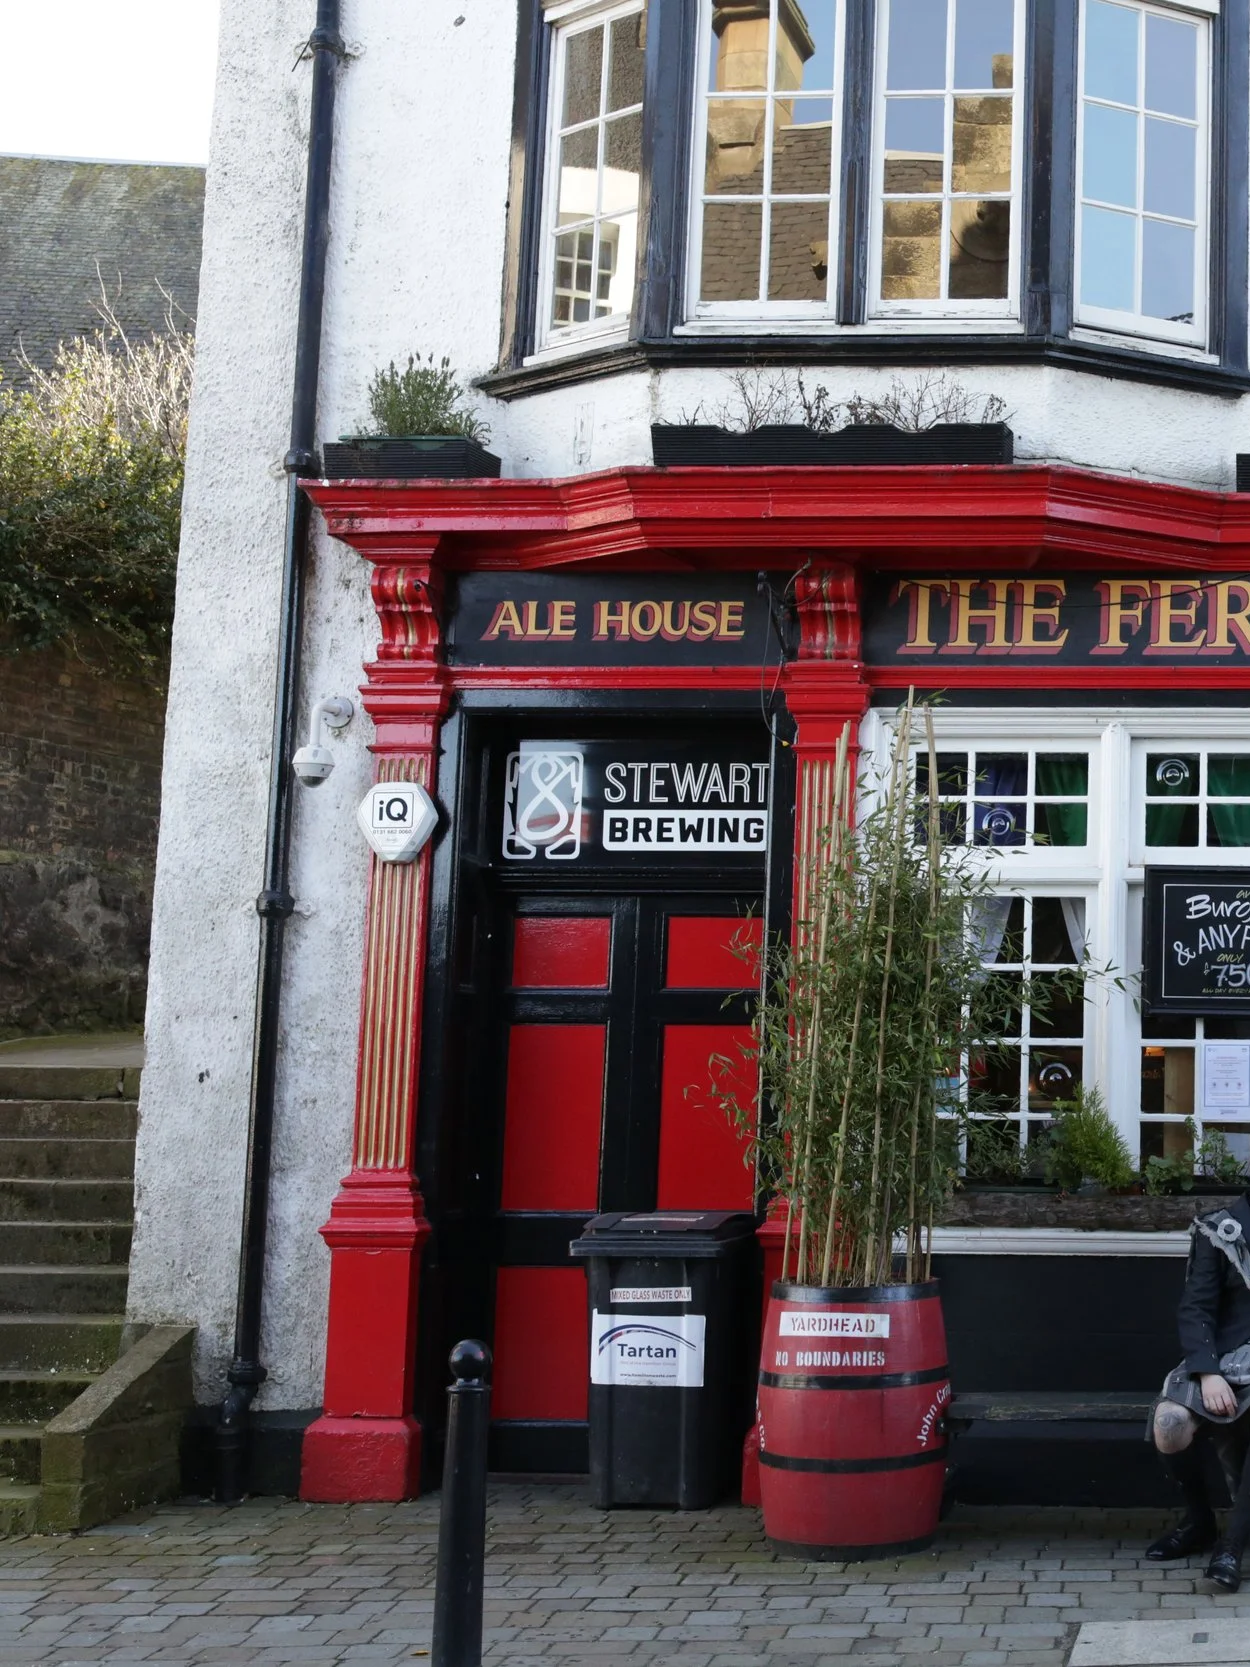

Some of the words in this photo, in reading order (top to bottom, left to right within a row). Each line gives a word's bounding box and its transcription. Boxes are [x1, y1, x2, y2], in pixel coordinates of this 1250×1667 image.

[480, 599, 577, 643] ALE
[592, 599, 746, 643] HOUSE
[890, 578, 1069, 656] THE
[603, 762, 770, 803] STEWART
[378, 797, 409, 823] iQ
[608, 817, 764, 843] BREWING
[1173, 940, 1197, 967] &
[1198, 924, 1242, 955] ANY
[1216, 953, 1244, 963] ONLY
[612, 1290, 631, 1301] MIXED
[631, 1290, 650, 1300] GLASS
[651, 1290, 673, 1300] WASTE
[673, 1289, 691, 1300] ONLY
[791, 1317, 876, 1334] YARDHEAD
[617, 1343, 677, 1359] Tartan
[775, 1351, 789, 1367] NO
[796, 1351, 886, 1367] BOUNDARIES
[916, 1403, 938, 1447] John
